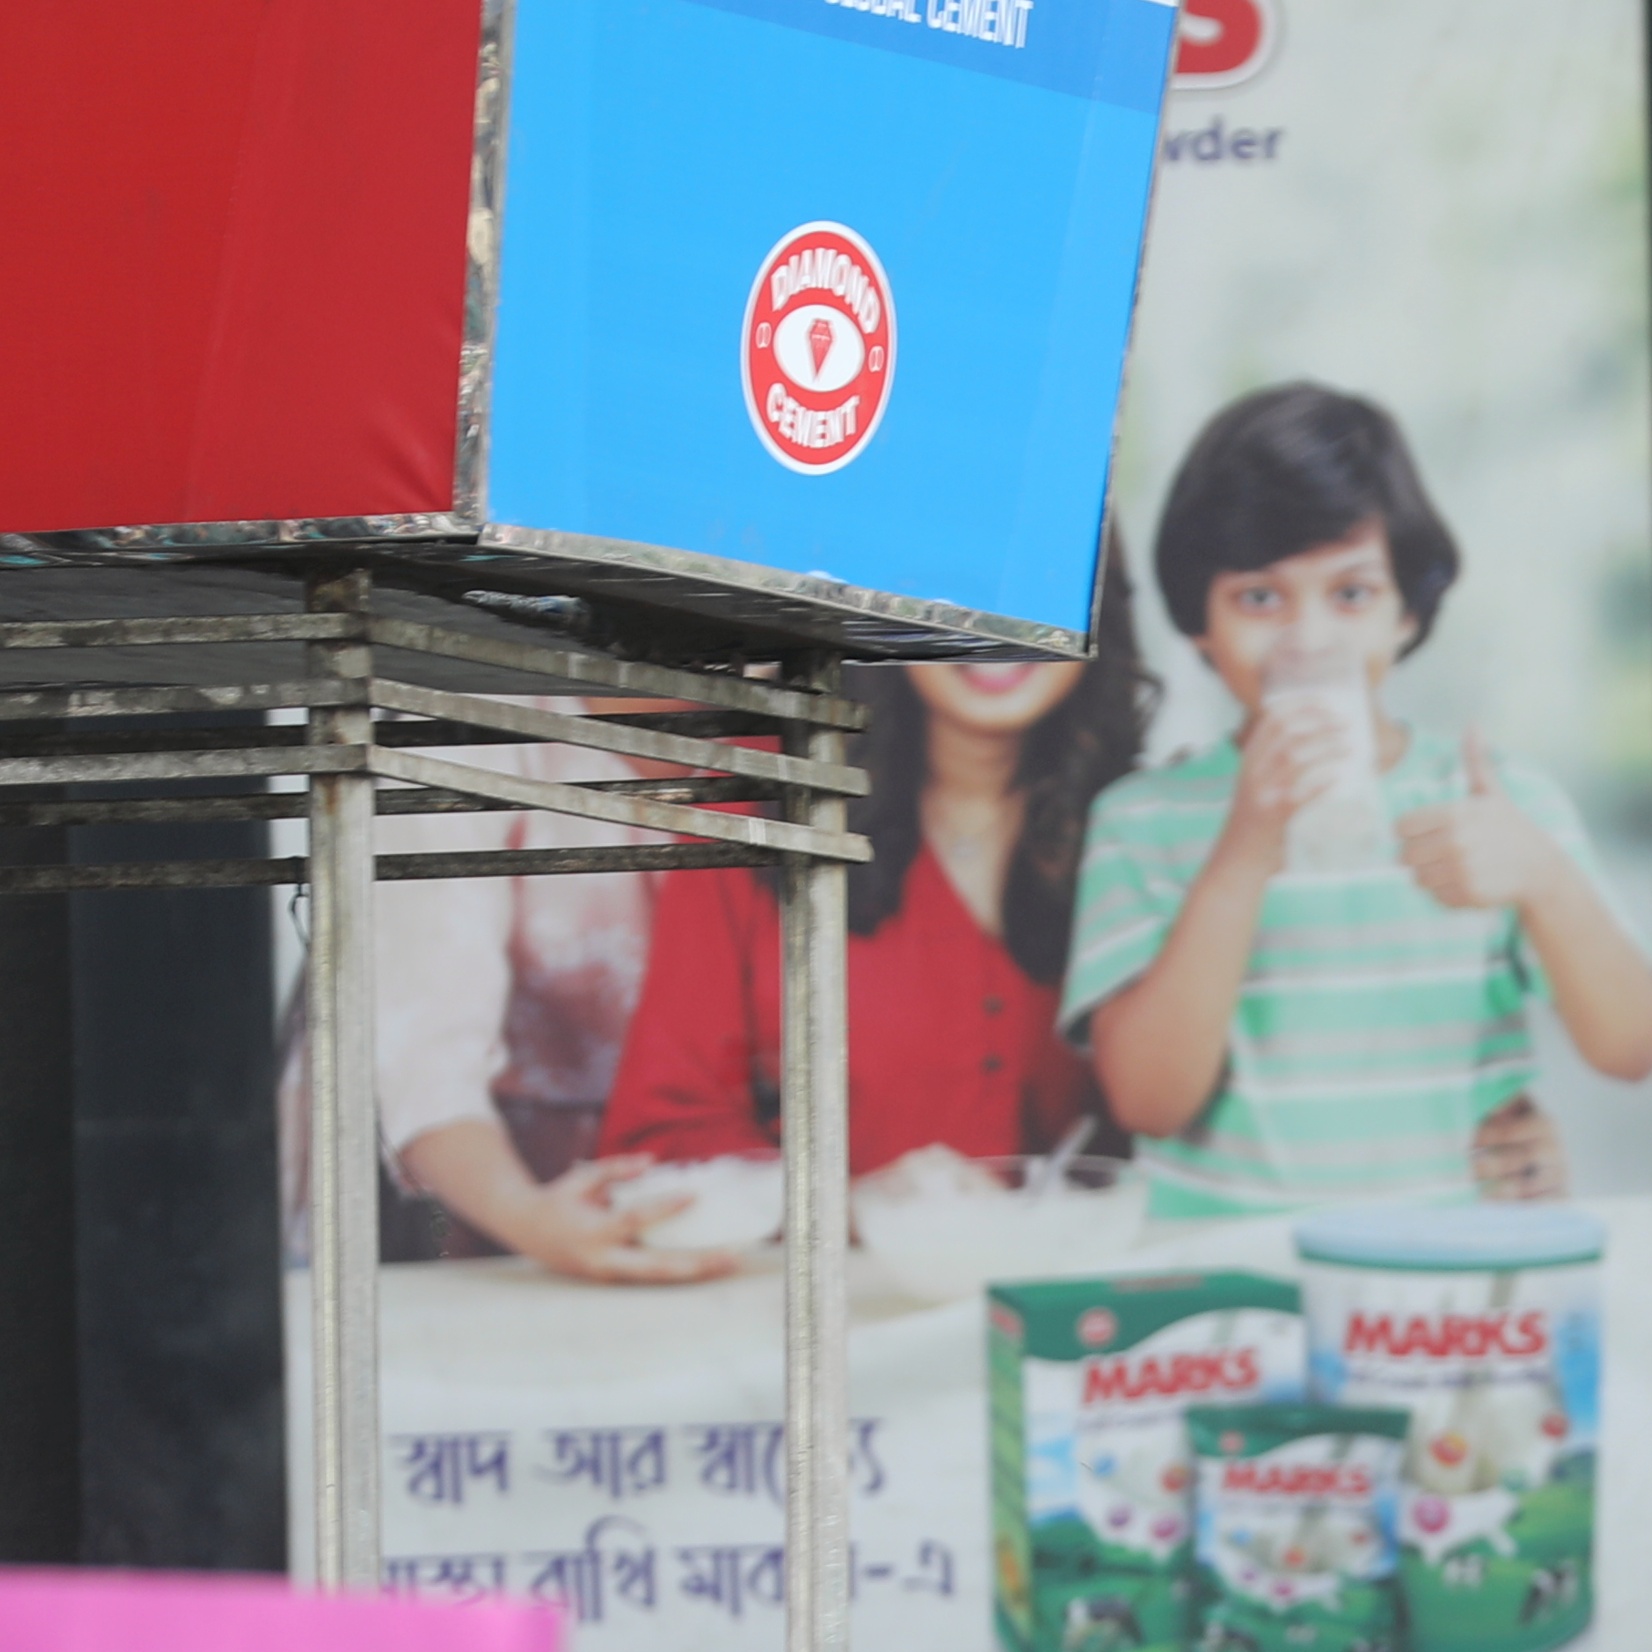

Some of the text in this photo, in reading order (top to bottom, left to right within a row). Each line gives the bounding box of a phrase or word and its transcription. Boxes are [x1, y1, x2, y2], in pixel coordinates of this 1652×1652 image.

[770, 247, 881, 334] DIAMOND
[766, 382, 861, 449] CEMENT
[1343, 1309, 1549, 1359] MARKS
[1081, 1346, 1260, 1408] MARKS
[388, 1429, 513, 1504] স্বাদ
[533, 1424, 667, 1501] আর
[1222, 1462, 1373, 1498] MARKS
